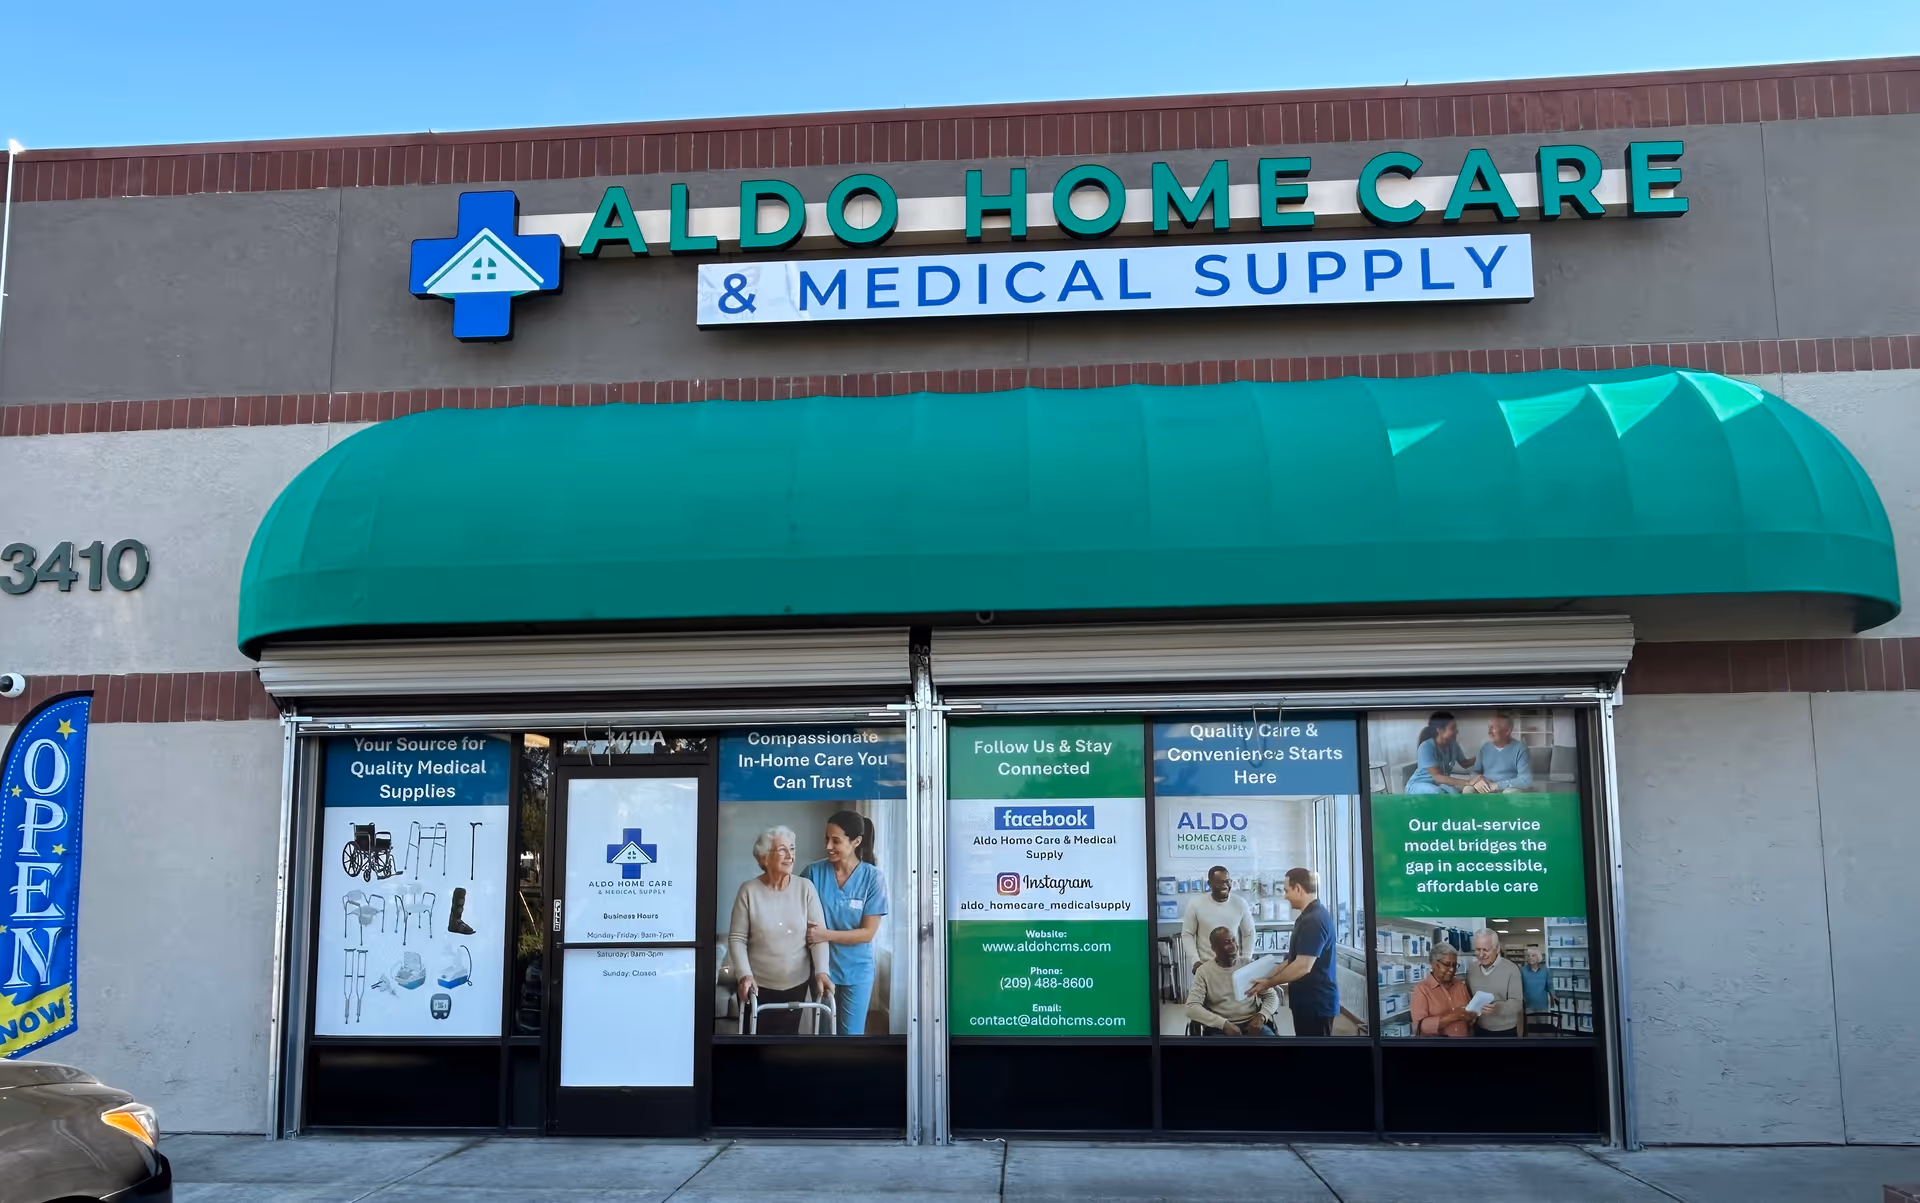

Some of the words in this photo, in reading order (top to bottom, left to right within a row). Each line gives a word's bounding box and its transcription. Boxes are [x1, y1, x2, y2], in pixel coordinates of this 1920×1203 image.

[578, 173, 899, 258] ALDO
[965, 157, 1315, 243] HOME
[1356, 141, 1690, 228] CARE
[718, 273, 757, 314] &
[799, 258, 1152, 312] MEDICAL
[1194, 245, 1508, 297] SUPPLY
[0, 539, 150, 595] 3410
[748, 731, 879, 747] Compassionate
[1190, 723, 1253, 741] Quality
[1259, 723, 1301, 737] Care
[1305, 723, 1318, 737] &
[354, 737, 392, 752] Your
[396, 737, 457, 751] Source
[461, 736, 486, 750] for
[974, 740, 1029, 754] Follow
[1033, 740, 1055, 753] Us
[1059, 740, 1071, 753] &
[1075, 739, 1112, 755] Stay
[738, 753, 809, 768] In-Home
[814, 753, 853, 766] Care
[857, 752, 888, 765] You
[1167, 747, 1284, 762] Convenience
[1289, 746, 1343, 760] Starts
[350, 761, 413, 778] Quality
[417, 760, 486, 775] Medical
[998, 762, 1090, 775] Connected
[773, 776, 806, 789] Can
[810, 775, 852, 789] Trust
[1234, 770, 1277, 784] Here
[380, 784, 456, 800] Supplies
[1003, 808, 1088, 827] facebook
[1177, 812, 1248, 831] ALDO
[1408, 818, 1438, 832] Our
[1441, 818, 1541, 832] dual-service
[973, 836, 998, 846] Aldo
[1001, 836, 1032, 845] Home
[1035, 835, 1060, 845] Care
[1064, 835, 1071, 845] &
[1073, 835, 1116, 845] Medical
[1177, 833, 1237, 842] HOMECARE
[1404, 839, 1454, 852] model
[1458, 838, 1517, 854] bridges
[1520, 838, 1547, 852] the
[3, 738, 69, 989] OPEN
[1026, 850, 1064, 861] Supply
[1405, 860, 1434, 875] gap
[1437, 859, 1452, 872] in
[1456, 859, 1547, 875] accessible,
[1023, 874, 1093, 895] Instagram
[1417, 880, 1500, 894] affordable
[1503, 883, 1539, 893] care
[961, 900, 1131, 911] aldo_homecare_medicalsupply
[603, 912, 635, 920] Business
[1025, 929, 1067, 939] Website:
[982, 940, 1111, 952] www.aldohcms.com
[602, 969, 630, 978] Sunday:
[1030, 966, 1063, 975] Phone:
[1000, 977, 1031, 991] (209)
[1034, 977, 1094, 989] 488-8600
[1032, 1003, 1062, 1012] Email:
[0, 998, 65, 1045] NOW
[969, 1015, 1126, 1027] contact@aldohcms.com
